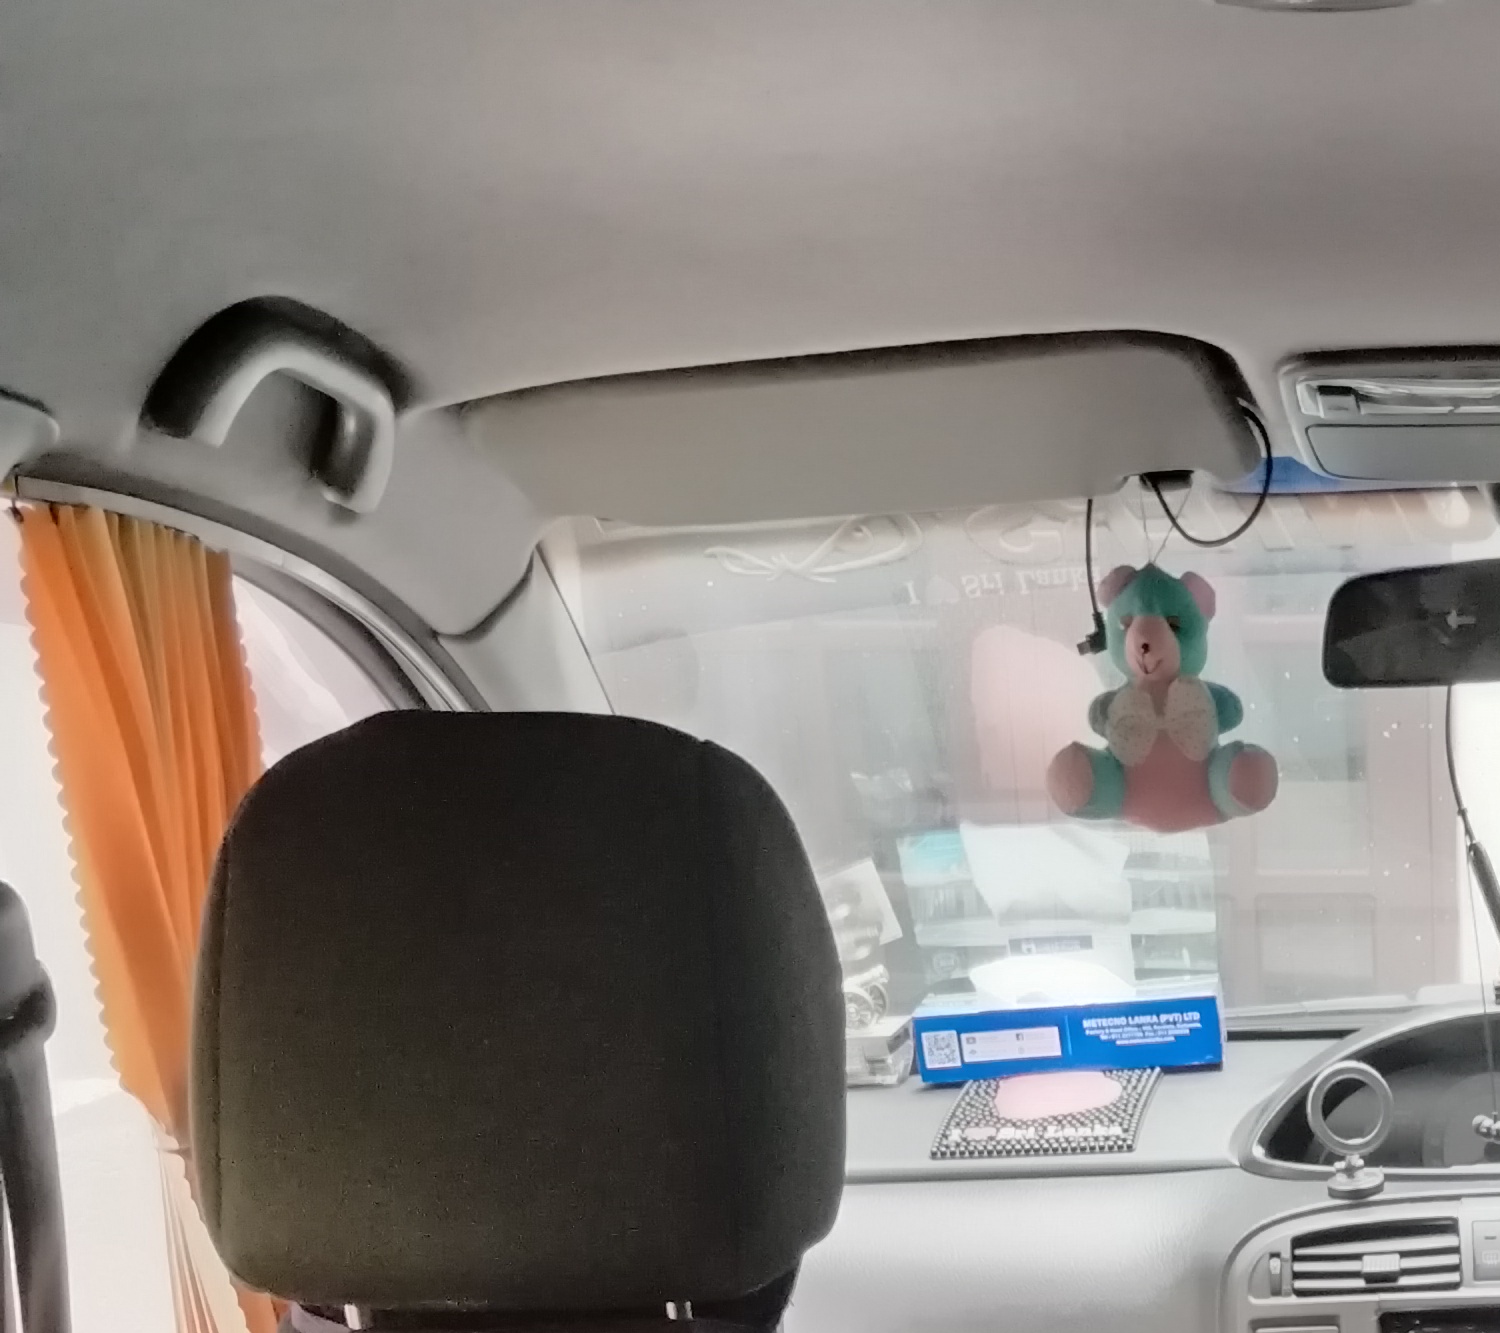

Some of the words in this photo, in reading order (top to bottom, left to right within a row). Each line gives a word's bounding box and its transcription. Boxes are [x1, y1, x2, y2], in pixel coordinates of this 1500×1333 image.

[1128, 1015, 1158, 1024] LANKA
[1159, 1013, 1182, 1023] (PVT)
[1183, 1012, 1200, 1021] LTD
